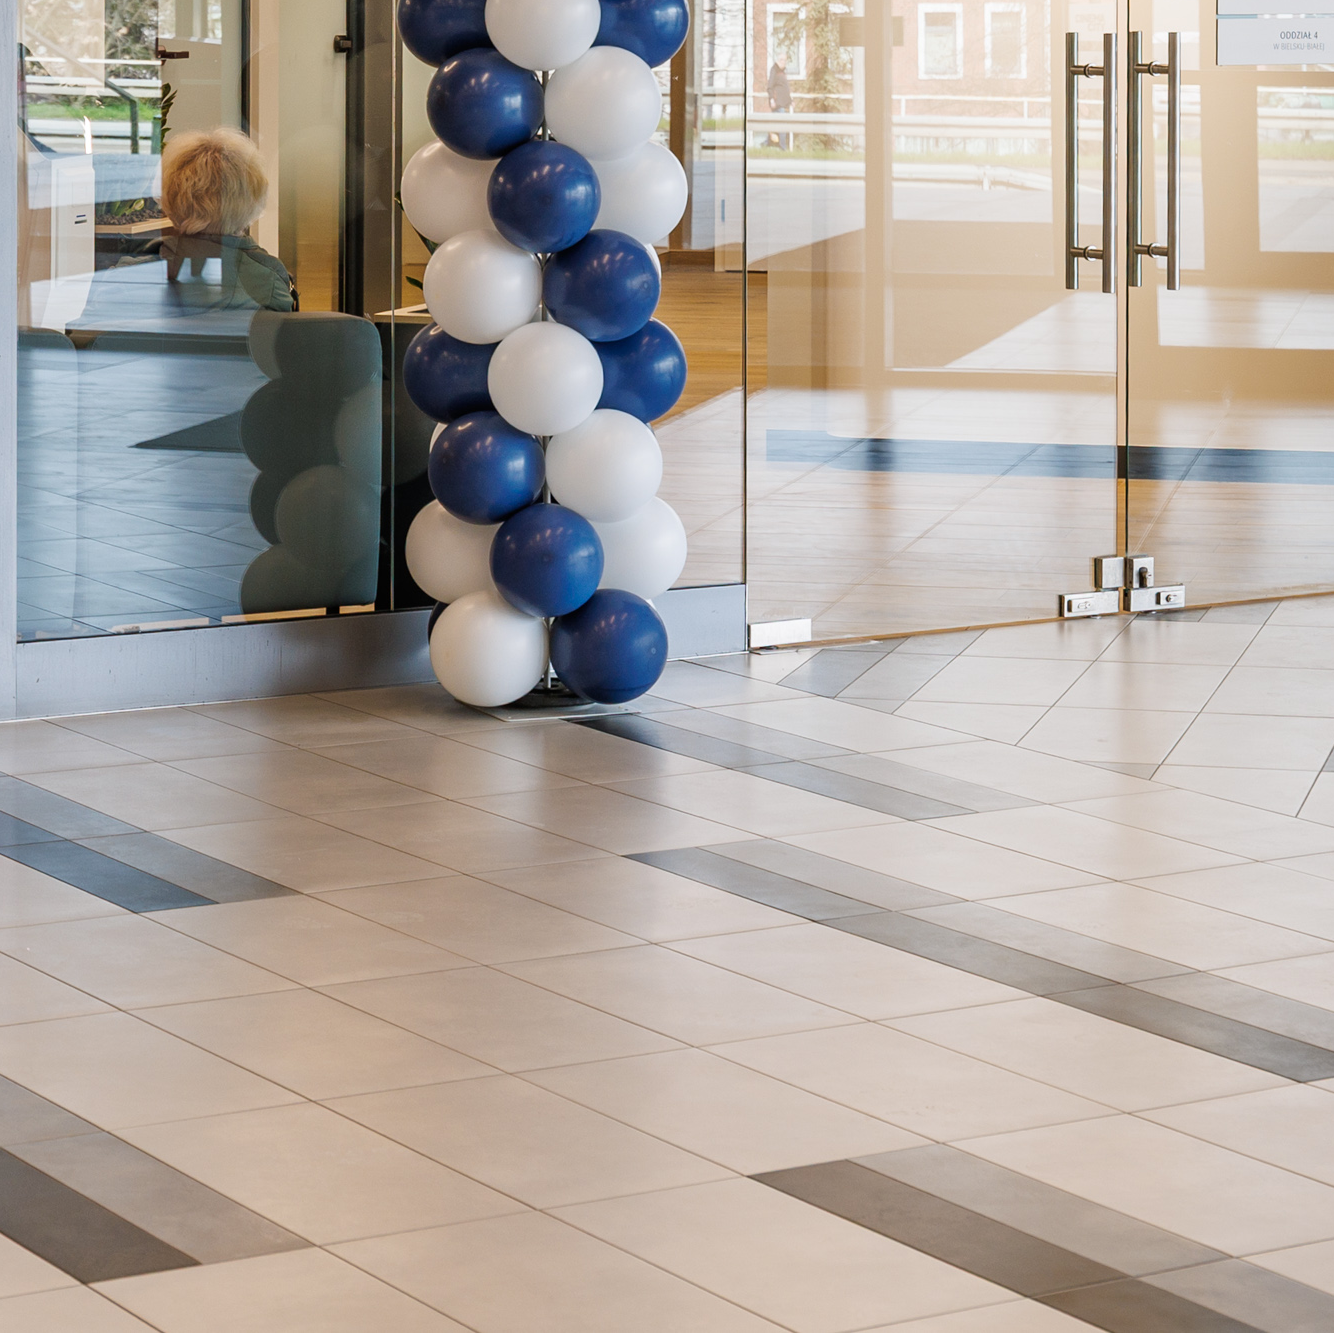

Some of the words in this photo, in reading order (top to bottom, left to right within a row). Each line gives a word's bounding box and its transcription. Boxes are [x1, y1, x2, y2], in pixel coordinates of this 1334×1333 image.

[1279, 30, 1312, 40] ODDZIAŁ
[1313, 31, 1319, 39] 4
[1280, 42, 1325, 52] BIELSKU-BIAŁEJ
